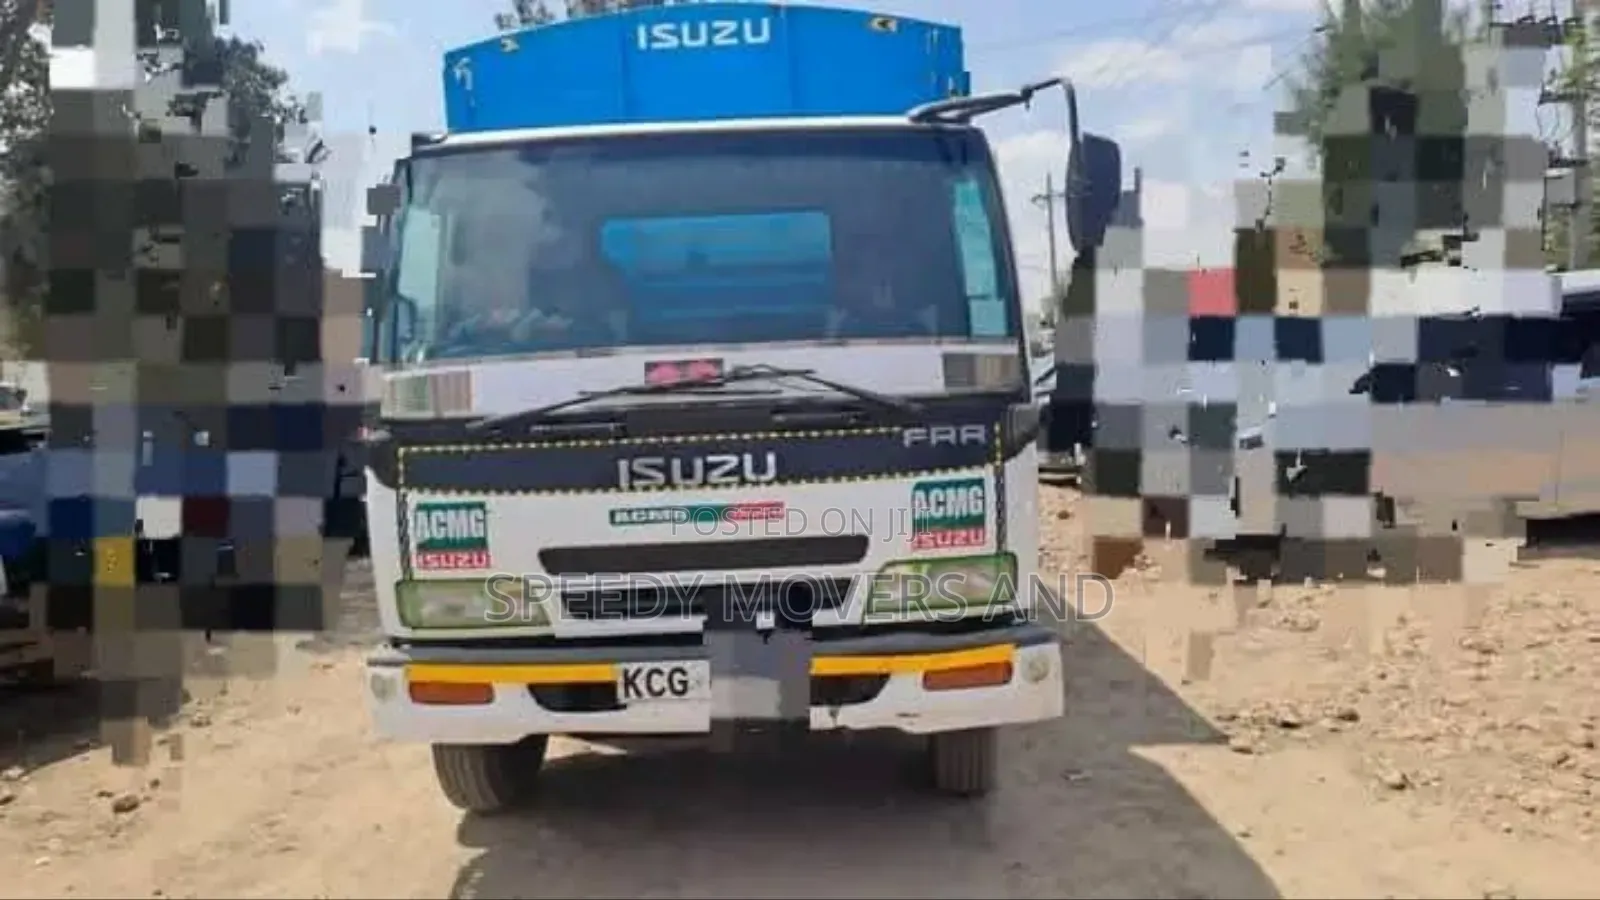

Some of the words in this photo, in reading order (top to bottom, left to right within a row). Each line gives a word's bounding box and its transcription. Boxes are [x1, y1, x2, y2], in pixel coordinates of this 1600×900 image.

[637, 17, 771, 50] ISUZU
[617, 451, 777, 489] ISUZU
[913, 484, 984, 520] ACMG
[415, 507, 486, 542] ACMG
[414, 551, 490, 569] ISUZU
[622, 667, 689, 699] KCG
